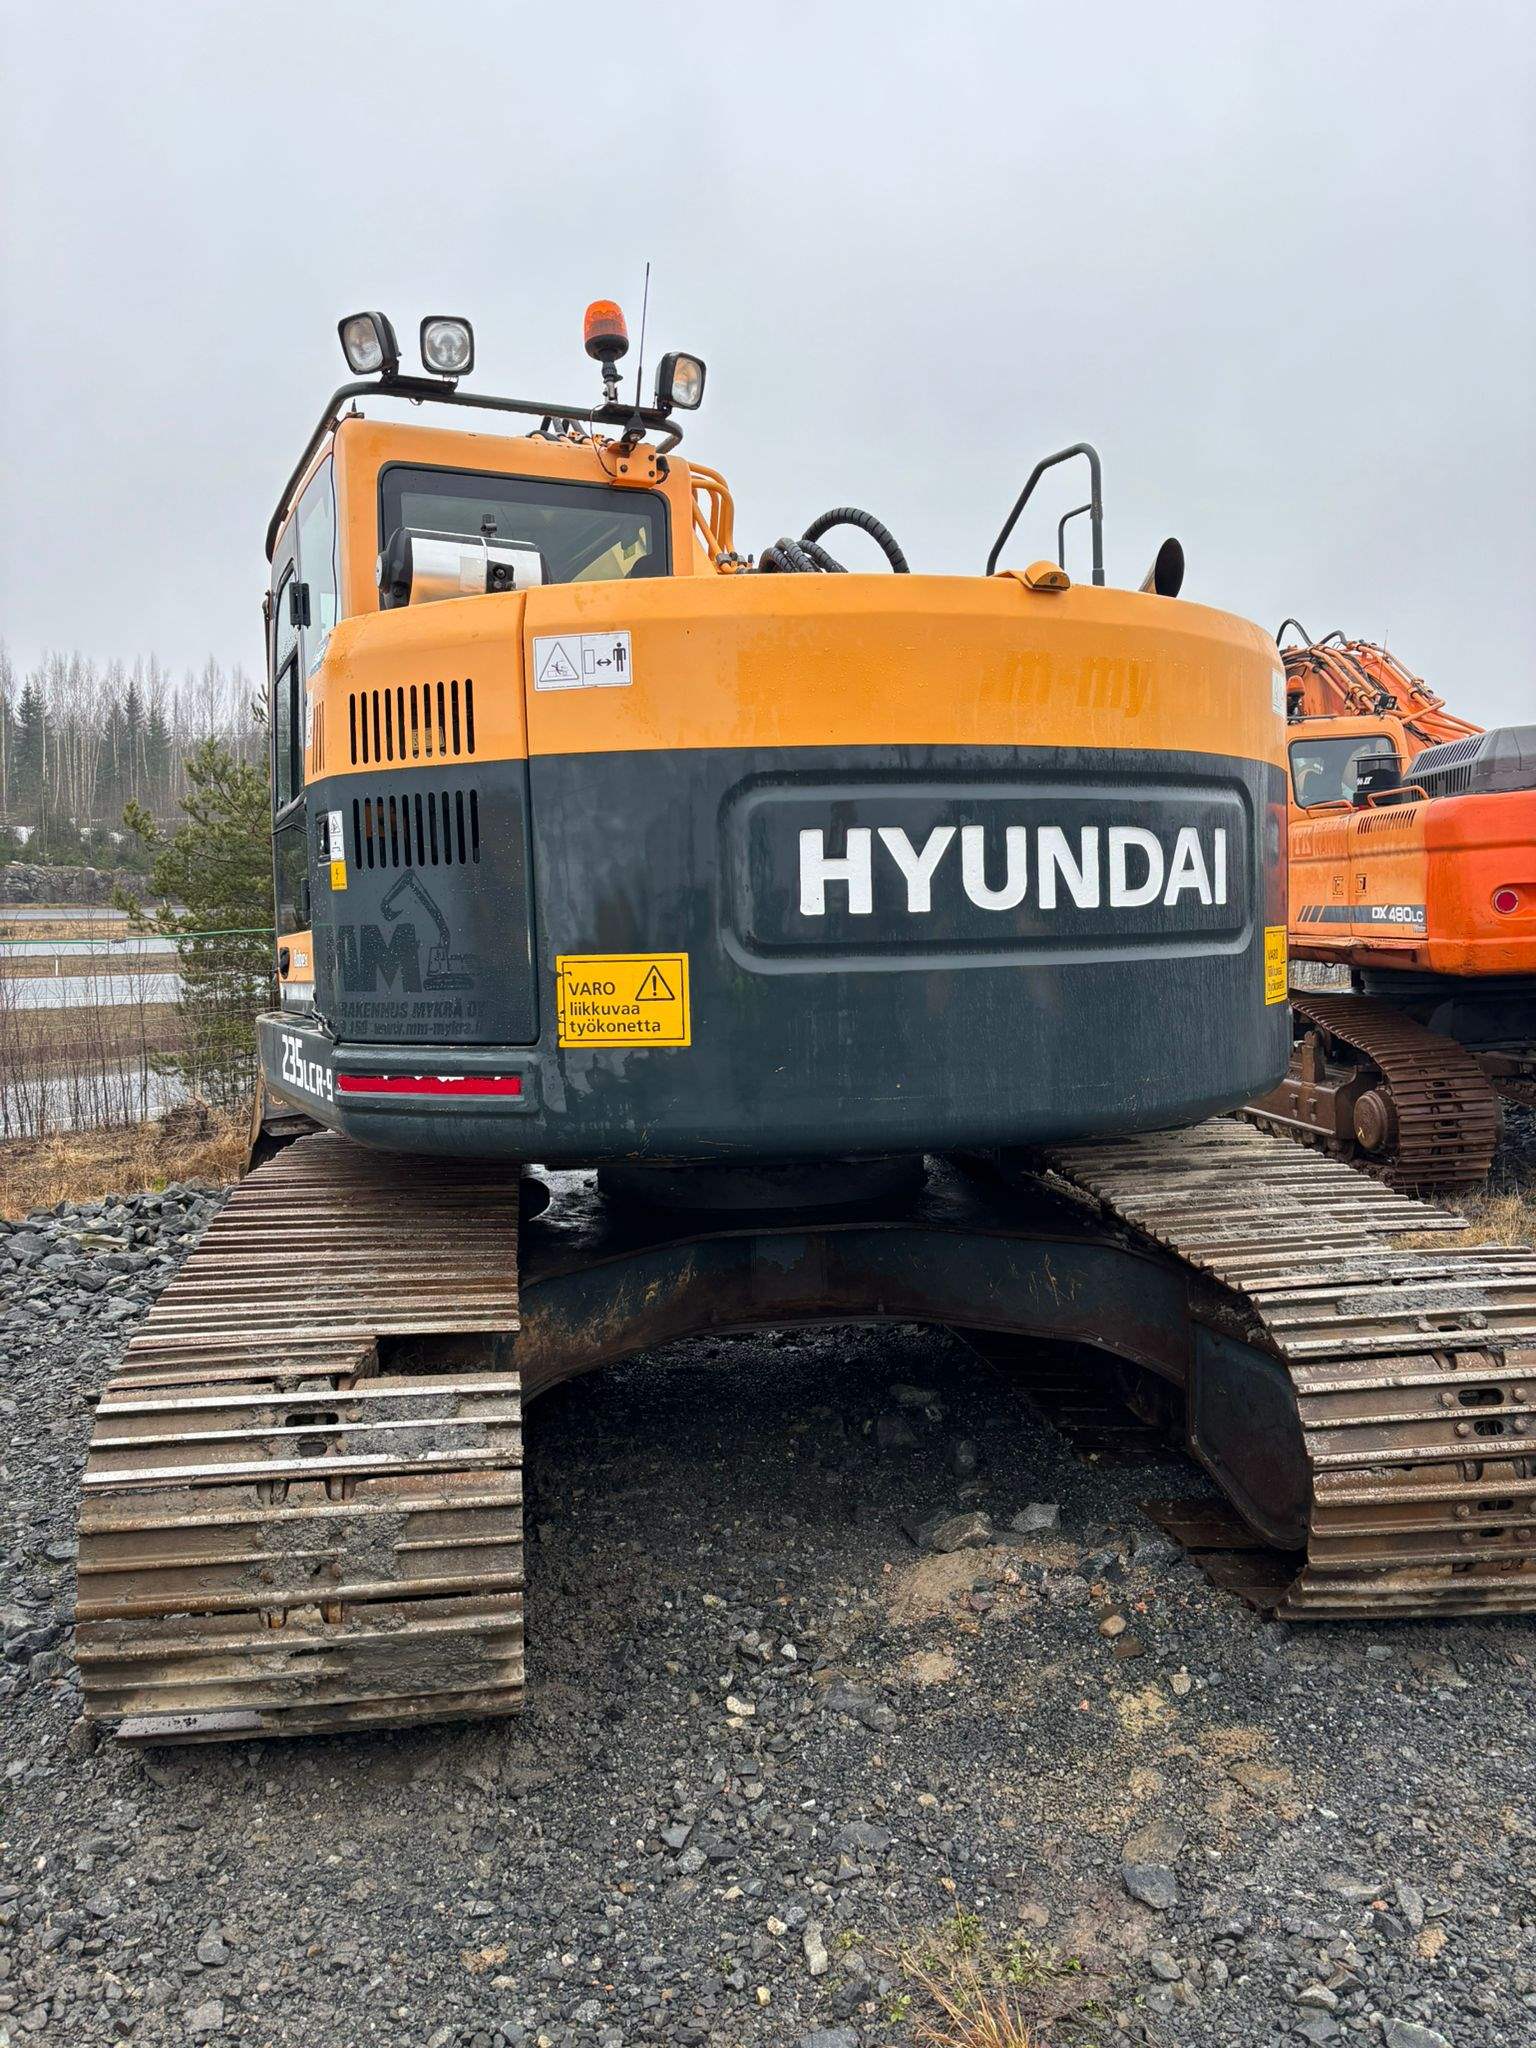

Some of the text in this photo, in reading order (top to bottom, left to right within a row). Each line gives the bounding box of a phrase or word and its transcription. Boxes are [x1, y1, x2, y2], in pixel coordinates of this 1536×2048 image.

[799, 825, 1228, 915] HYUNDAI
[1371, 904, 1424, 922] DX 480LC
[568, 982, 616, 996] VARO
[569, 1001, 640, 1016] liikkuvaa
[569, 1018, 661, 1037] työkonetta
